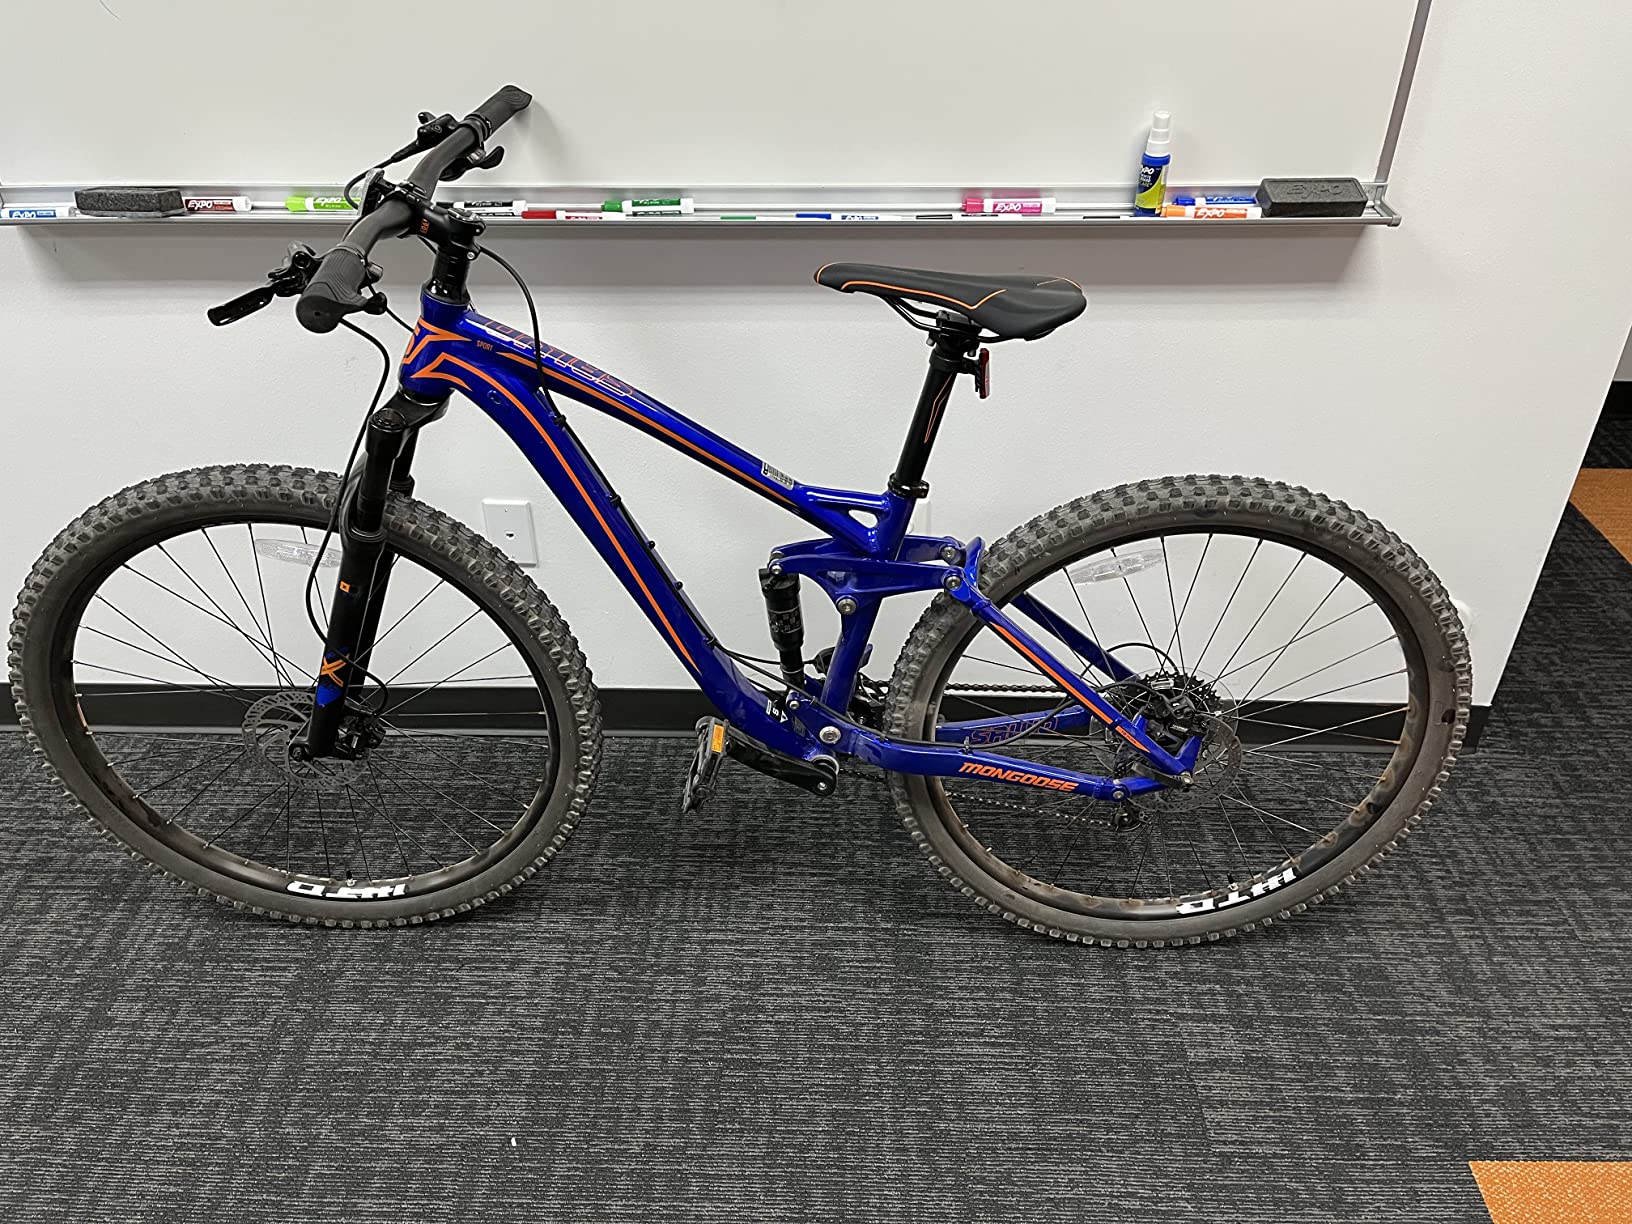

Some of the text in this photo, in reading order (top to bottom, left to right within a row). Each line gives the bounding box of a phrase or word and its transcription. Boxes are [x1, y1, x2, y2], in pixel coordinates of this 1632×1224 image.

[1287, 184, 1343, 199] EXPO
[188, 200, 213, 210] EXPO
[995, 203, 1021, 212] EXPO
[1197, 209, 1225, 219] EXPO
[476, 340, 493, 351] SPORT
[958, 761, 1079, 793] MONGOOSE
